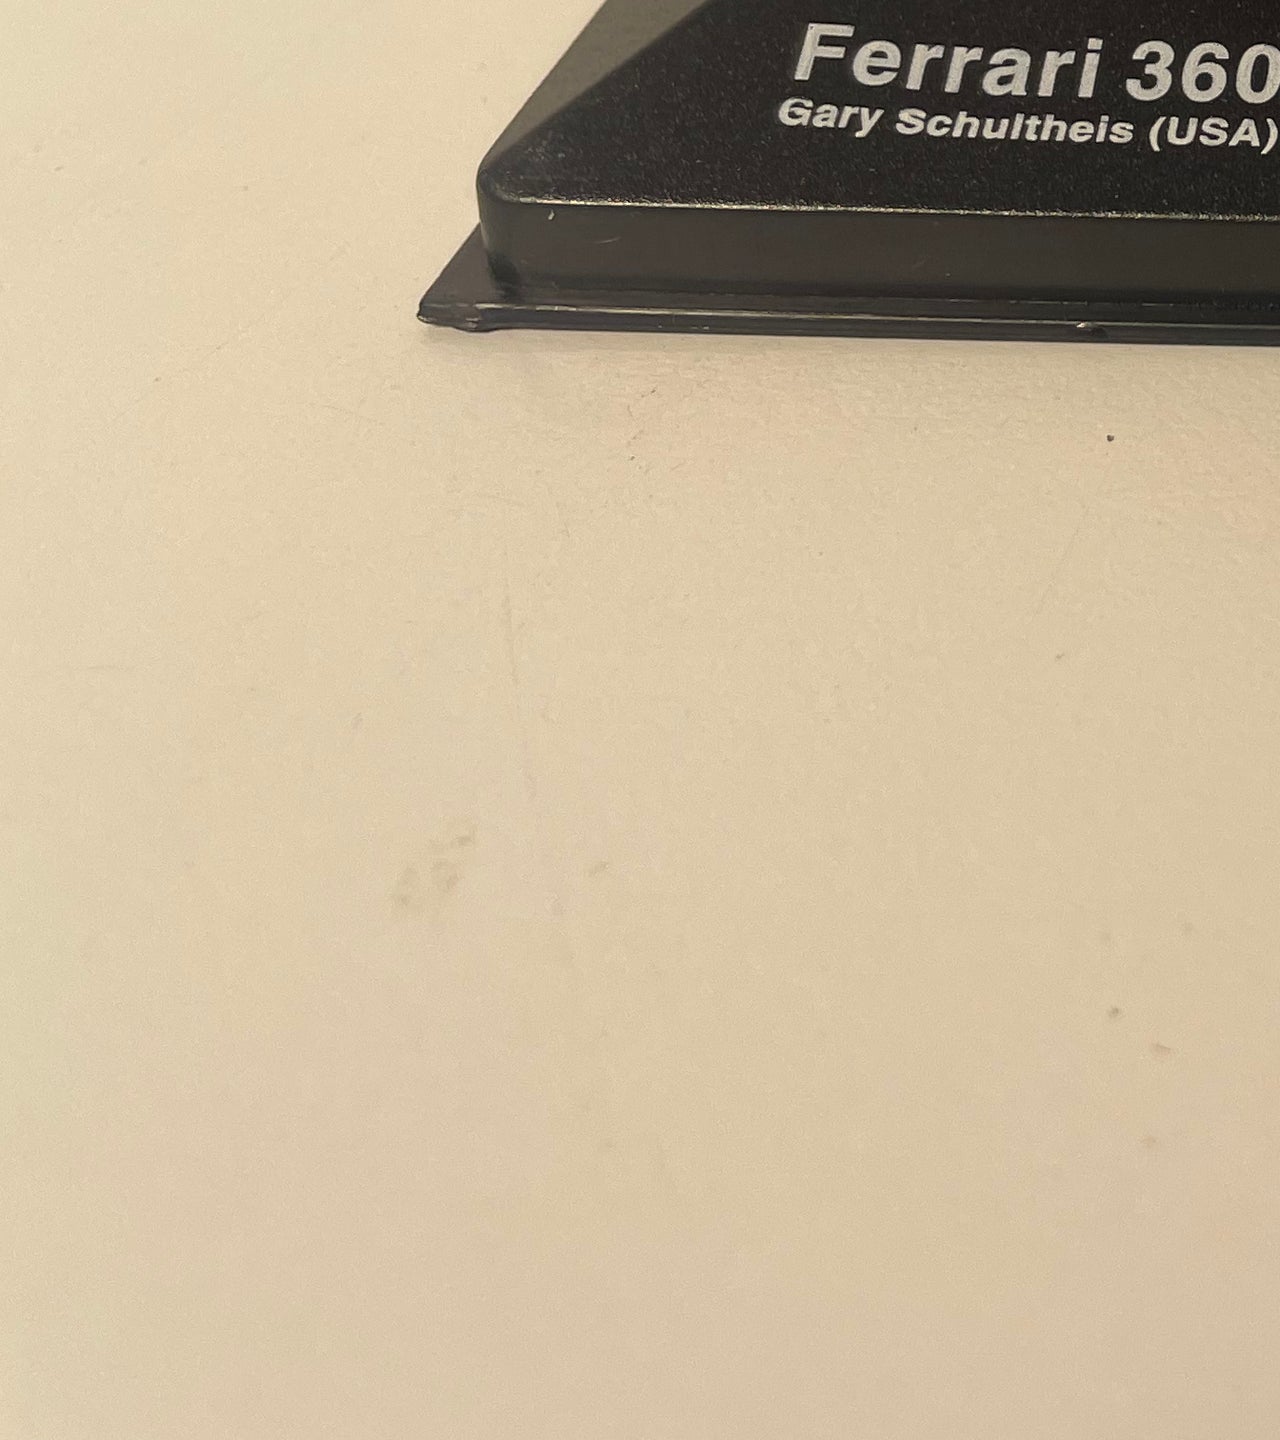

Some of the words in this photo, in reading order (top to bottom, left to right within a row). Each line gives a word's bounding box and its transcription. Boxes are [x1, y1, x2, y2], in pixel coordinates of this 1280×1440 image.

[793, 22, 1103, 98] Ferrari
[778, 97, 884, 138] Gary
[896, 108, 1134, 144] Schultheis
[1149, 116, 1278, 155] (USA)
